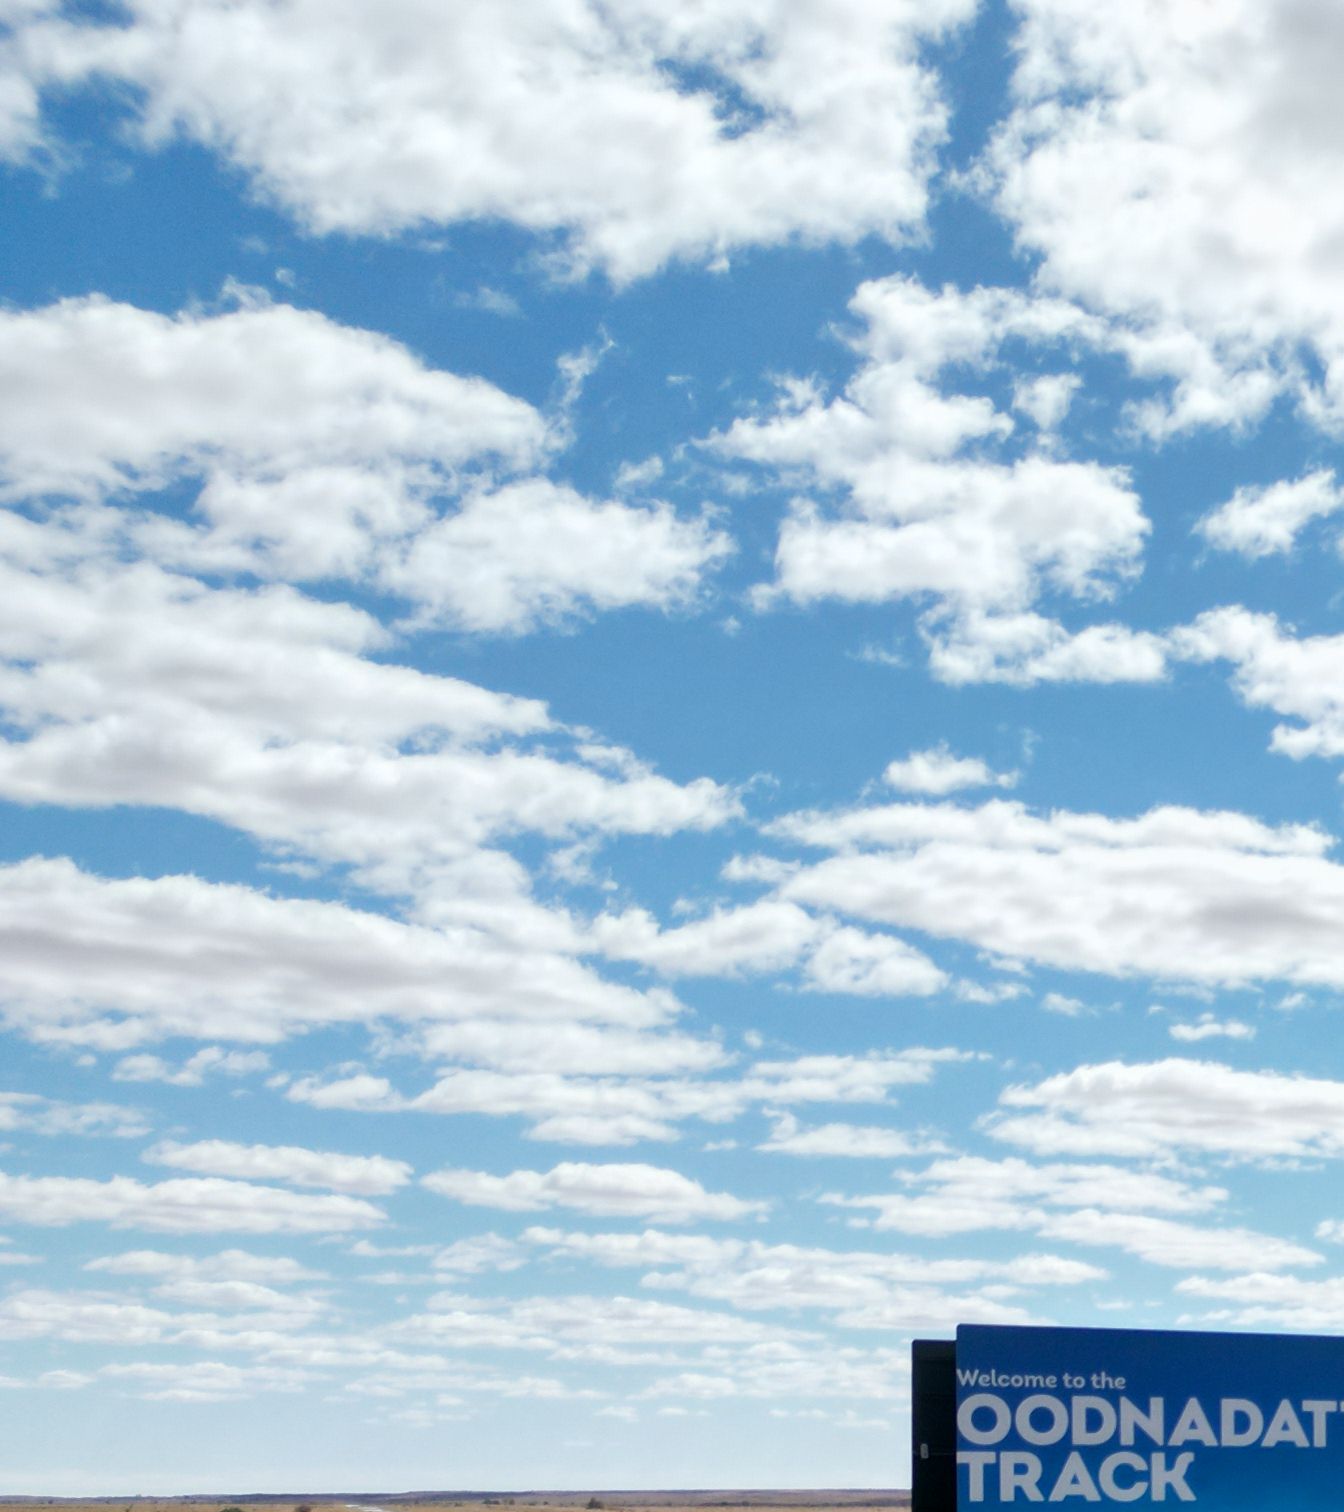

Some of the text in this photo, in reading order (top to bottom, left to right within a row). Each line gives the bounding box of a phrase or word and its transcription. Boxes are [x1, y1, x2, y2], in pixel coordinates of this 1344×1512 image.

[956, 1369, 1127, 1390] Welcome to the
[956, 1451, 1197, 1502] TRACK
